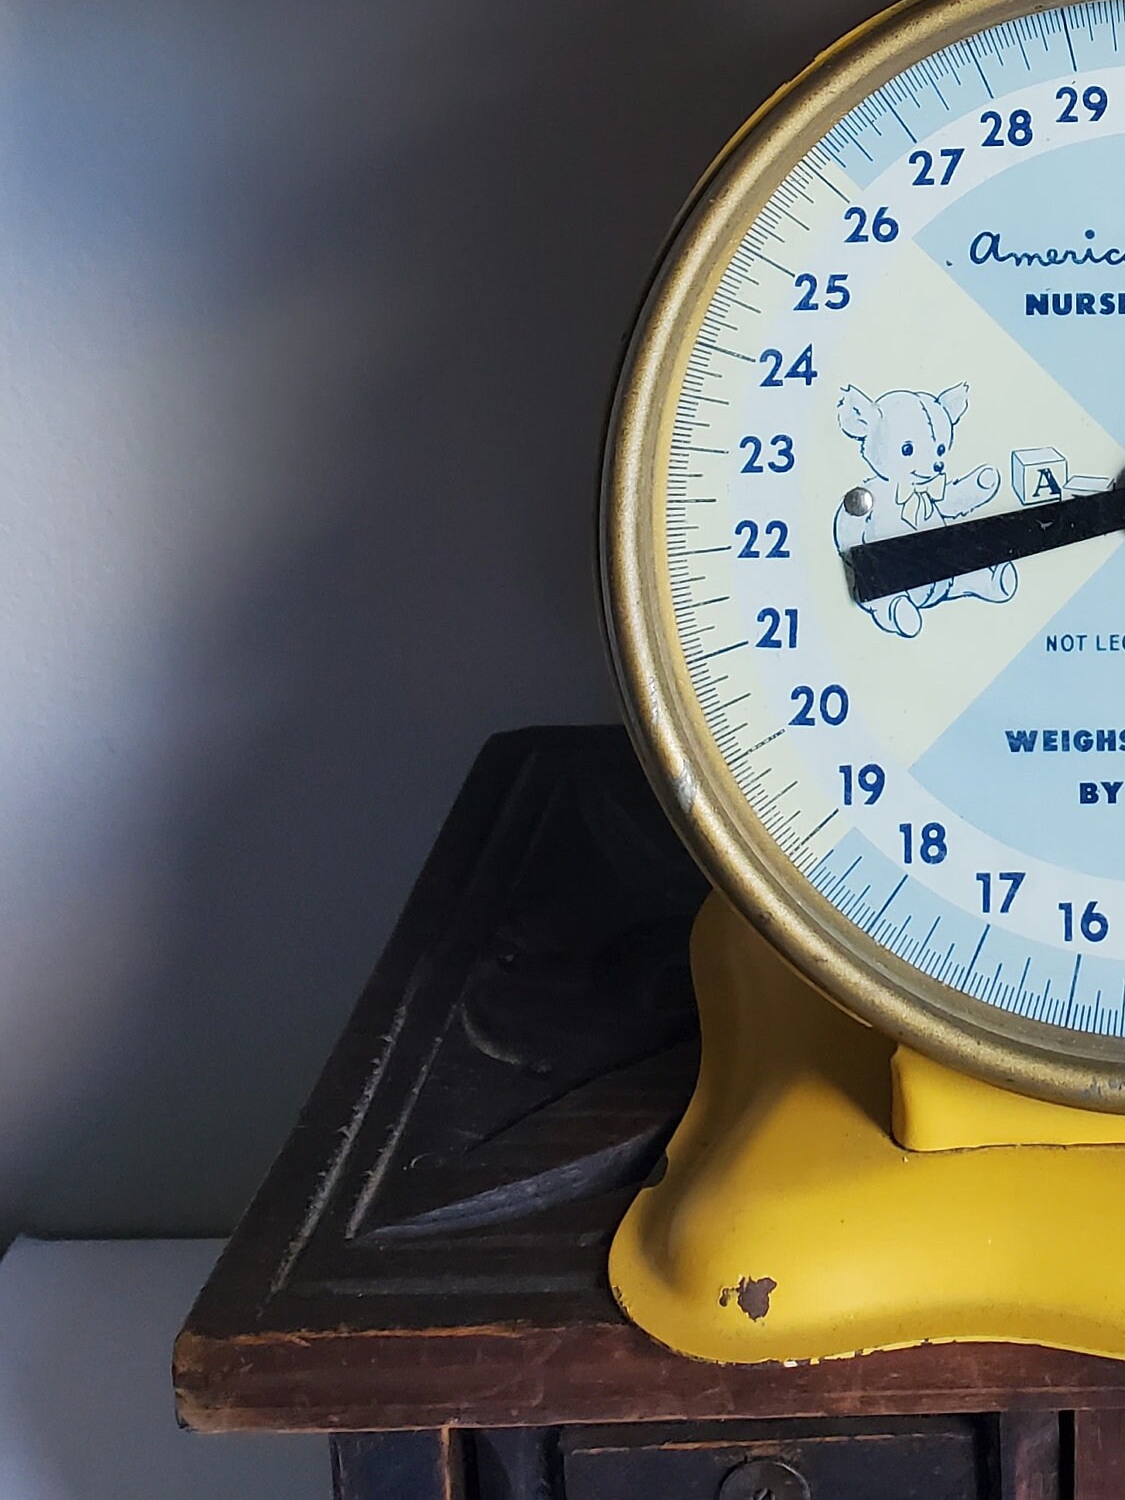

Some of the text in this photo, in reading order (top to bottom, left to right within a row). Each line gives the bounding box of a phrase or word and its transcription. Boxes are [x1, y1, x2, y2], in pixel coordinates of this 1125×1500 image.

[1055, 85, 1108, 123] 29
[980, 108, 1033, 147] 28
[908, 148, 965, 186] 27
[844, 206, 899, 243] 26
[793, 273, 851, 311] 25
[759, 343, 818, 388] 24
[739, 434, 795, 474] 23
[1032, 467, 1061, 497] A
[734, 519, 791, 559] 22
[755, 607, 798, 649] 21
[1046, 634, 1088, 652] NOT
[788, 684, 849, 727] 20
[838, 763, 886, 806] 19
[1079, 781, 1124, 805] BY
[899, 822, 948, 865] 18
[975, 871, 1026, 914] 17
[1058, 901, 1109, 943] 16
